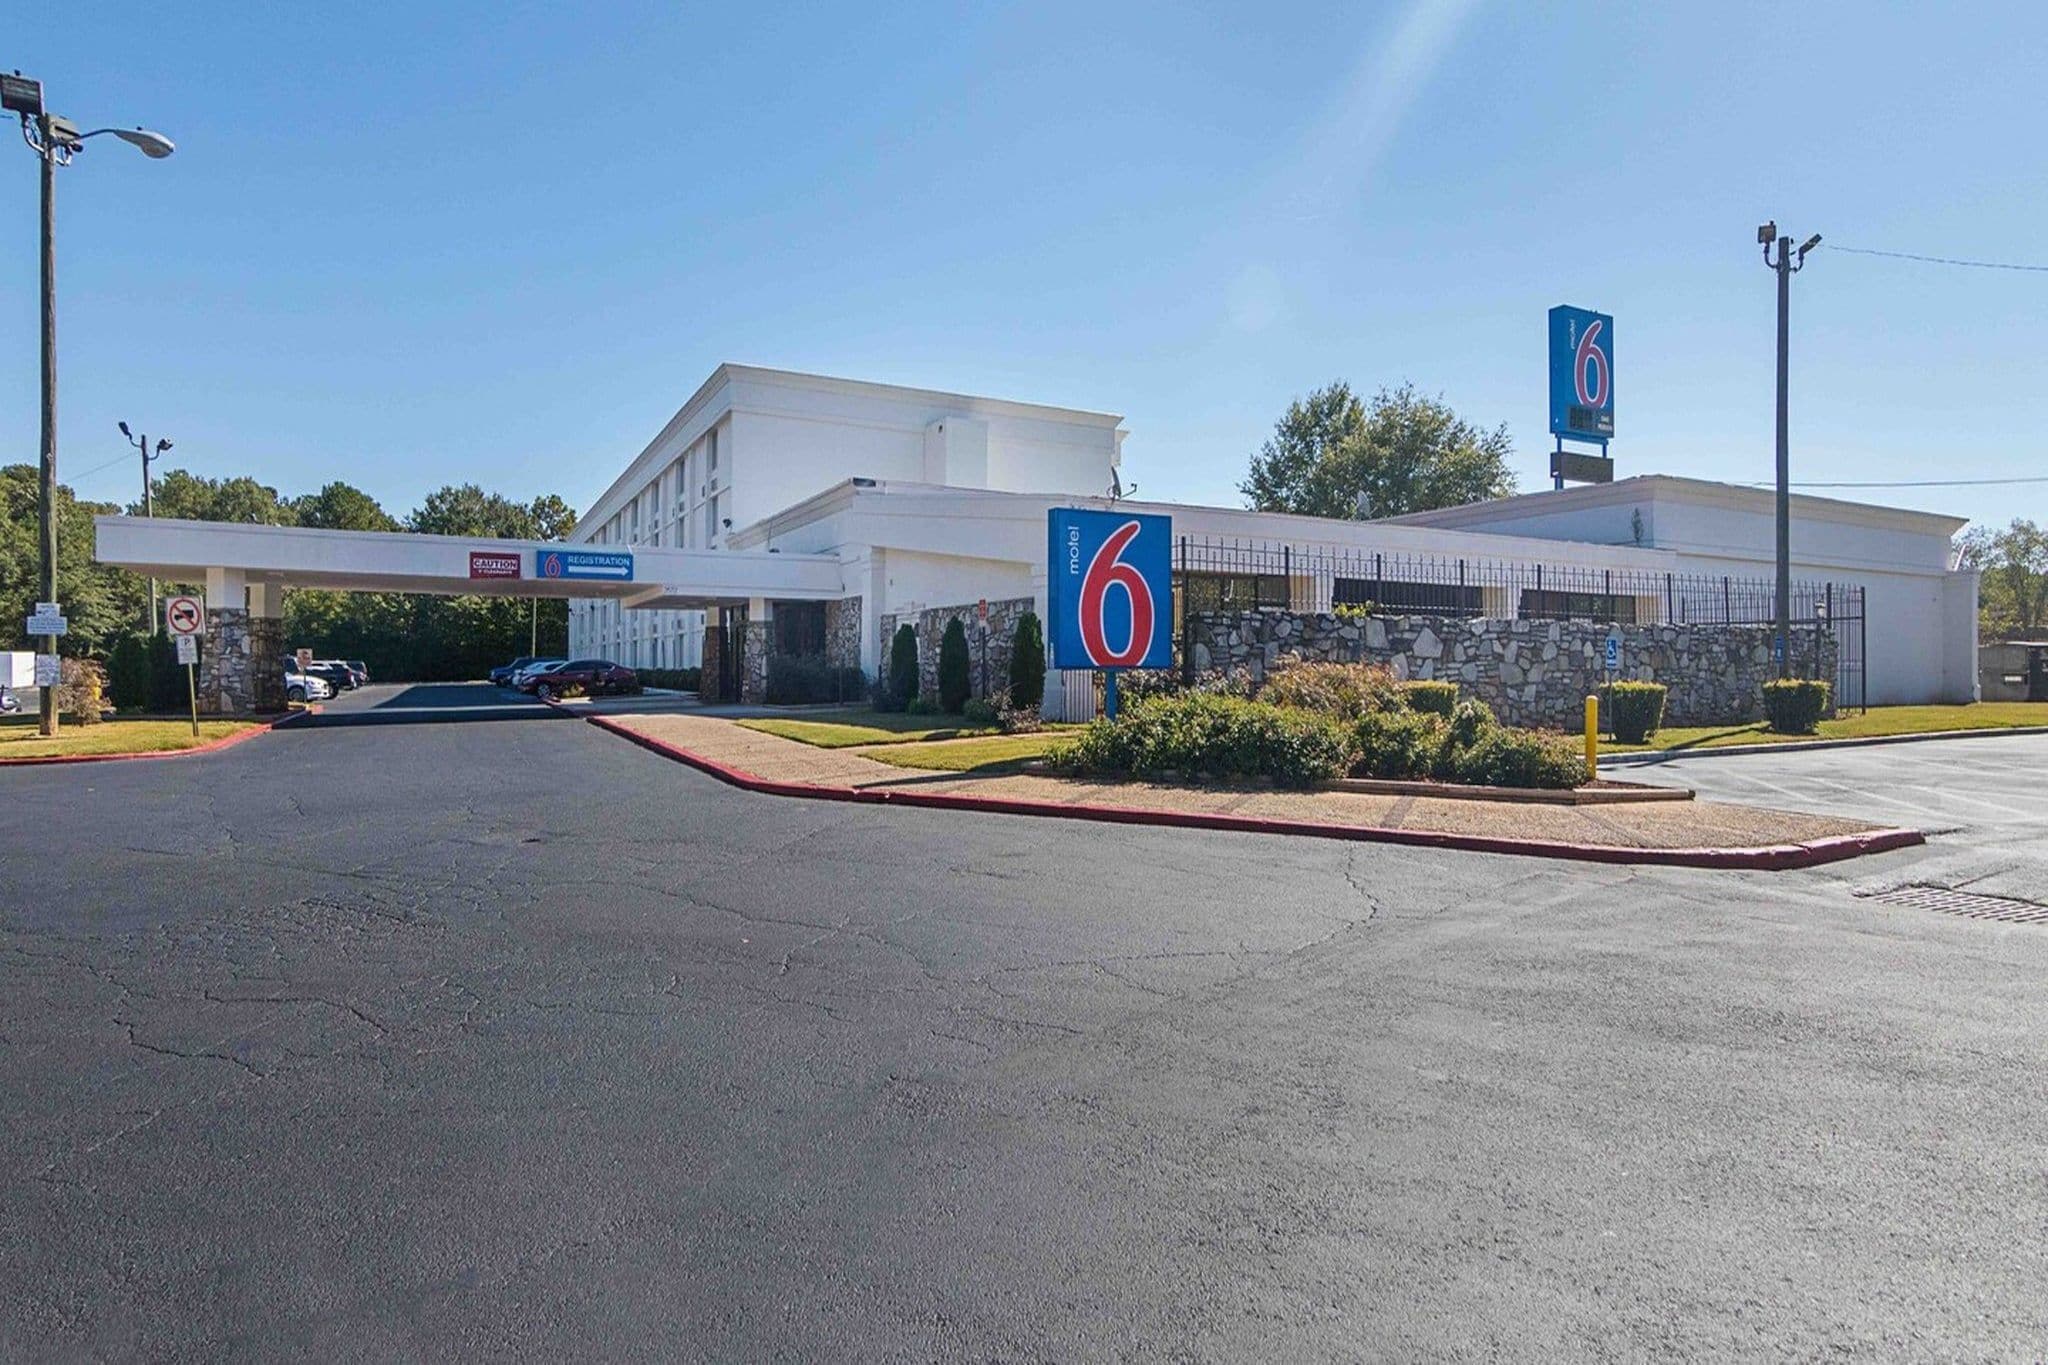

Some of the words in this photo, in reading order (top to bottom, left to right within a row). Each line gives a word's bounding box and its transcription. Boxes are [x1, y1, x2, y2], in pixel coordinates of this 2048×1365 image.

[1574, 320, 1609, 408] 6
[474, 560, 516, 569] CAUTION
[545, 553, 561, 577] 6
[568, 556, 629, 566] REGISTRATION
[1068, 526, 1079, 574] motel
[1078, 520, 1155, 666] 6
